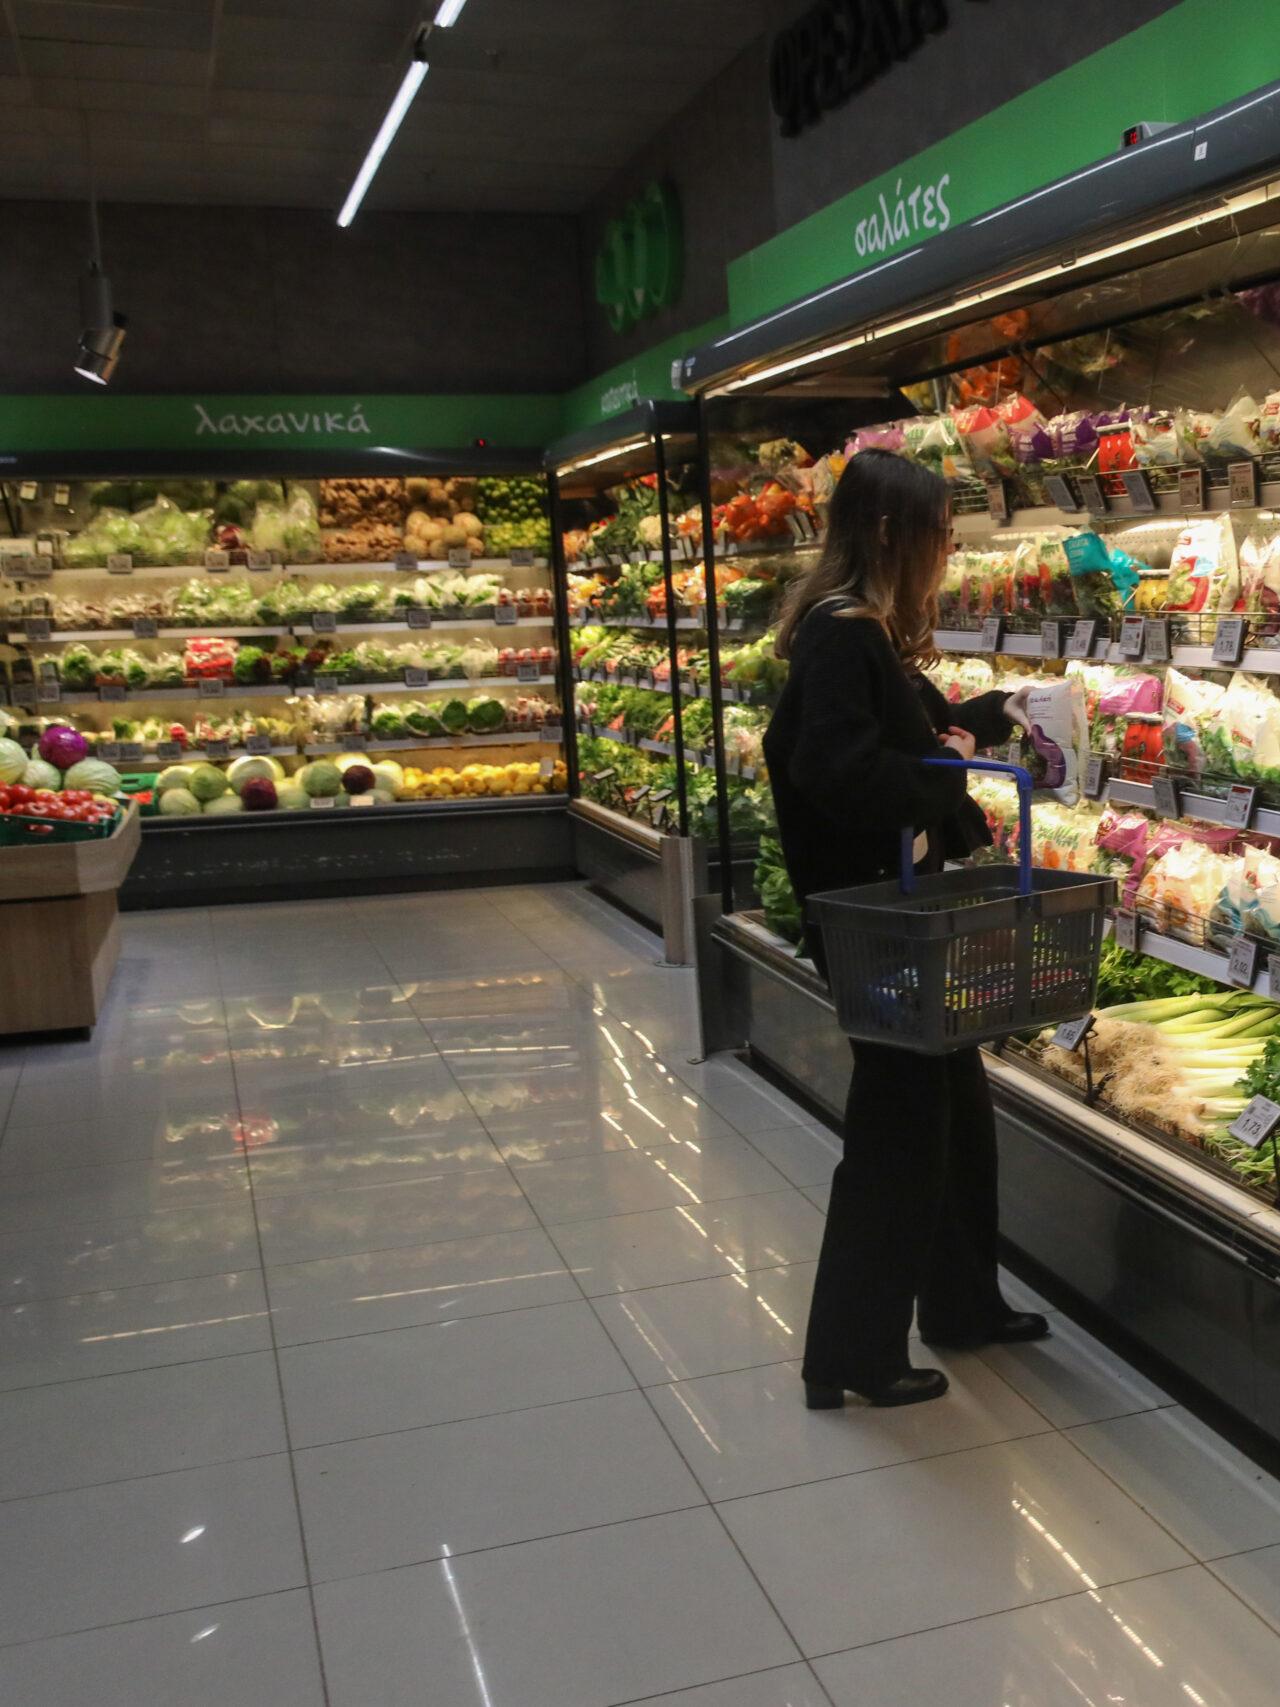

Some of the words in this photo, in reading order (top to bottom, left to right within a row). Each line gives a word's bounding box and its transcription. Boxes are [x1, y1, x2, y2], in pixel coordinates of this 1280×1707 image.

[854, 173, 951, 258] σαλάτες
[194, 403, 372, 436] λαχανικά
[1243, 1118, 1261, 1137] 1,73
